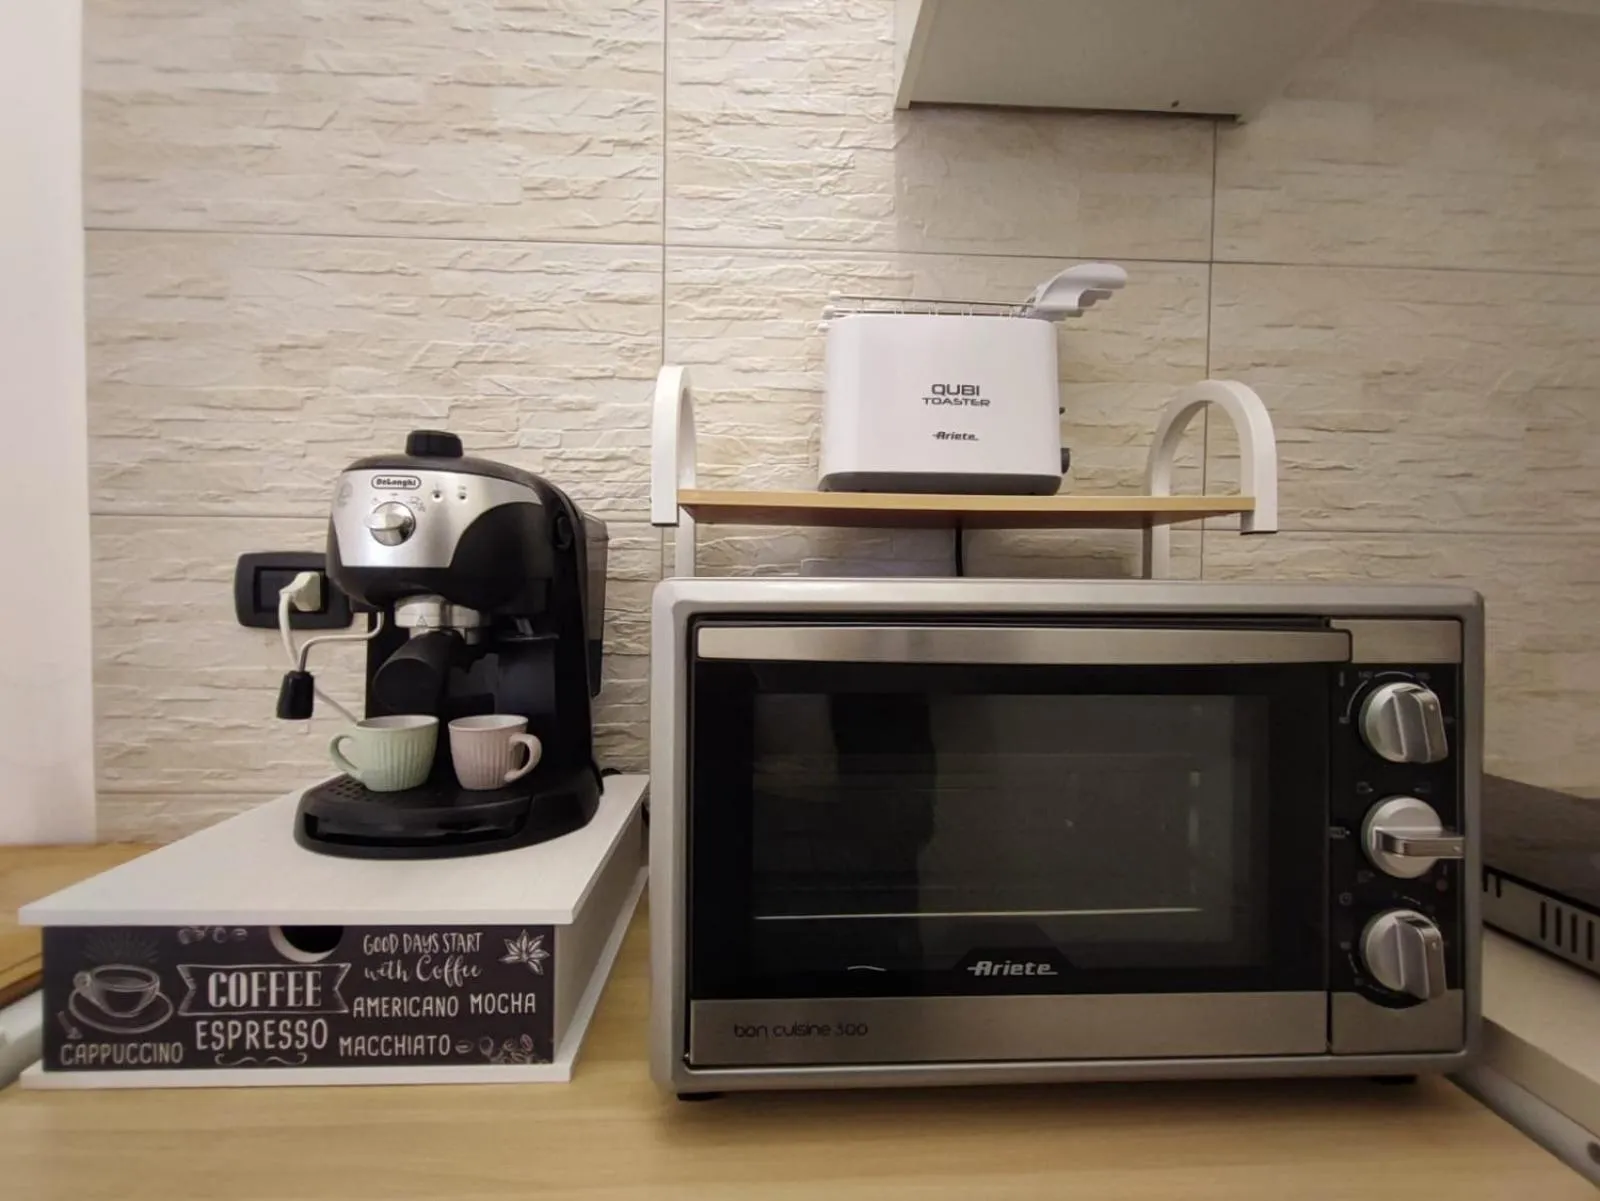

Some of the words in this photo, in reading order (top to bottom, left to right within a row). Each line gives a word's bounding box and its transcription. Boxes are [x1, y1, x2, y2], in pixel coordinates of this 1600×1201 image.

[931, 383, 980, 396] QUBI
[921, 397, 991, 407] TOASTER
[932, 431, 980, 441] Ariete
[363, 933, 399, 955] GOOD
[403, 932, 439, 954] DAYS
[442, 931, 483, 953] START
[364, 958, 410, 982] with
[416, 954, 482, 987] Coffee
[967, 960, 1058, 976] Ariete
[208, 970, 322, 1008] COFFEE
[353, 995, 459, 1018] AMERICANO
[469, 992, 536, 1014] MOCHA
[196, 1018, 328, 1050] ESPRESSO
[734, 1023, 768, 1038] bon
[772, 1021, 831, 1037] cuisine
[60, 1042, 183, 1065] CAPPUCCINO
[339, 1034, 450, 1057] MACCHIATO
